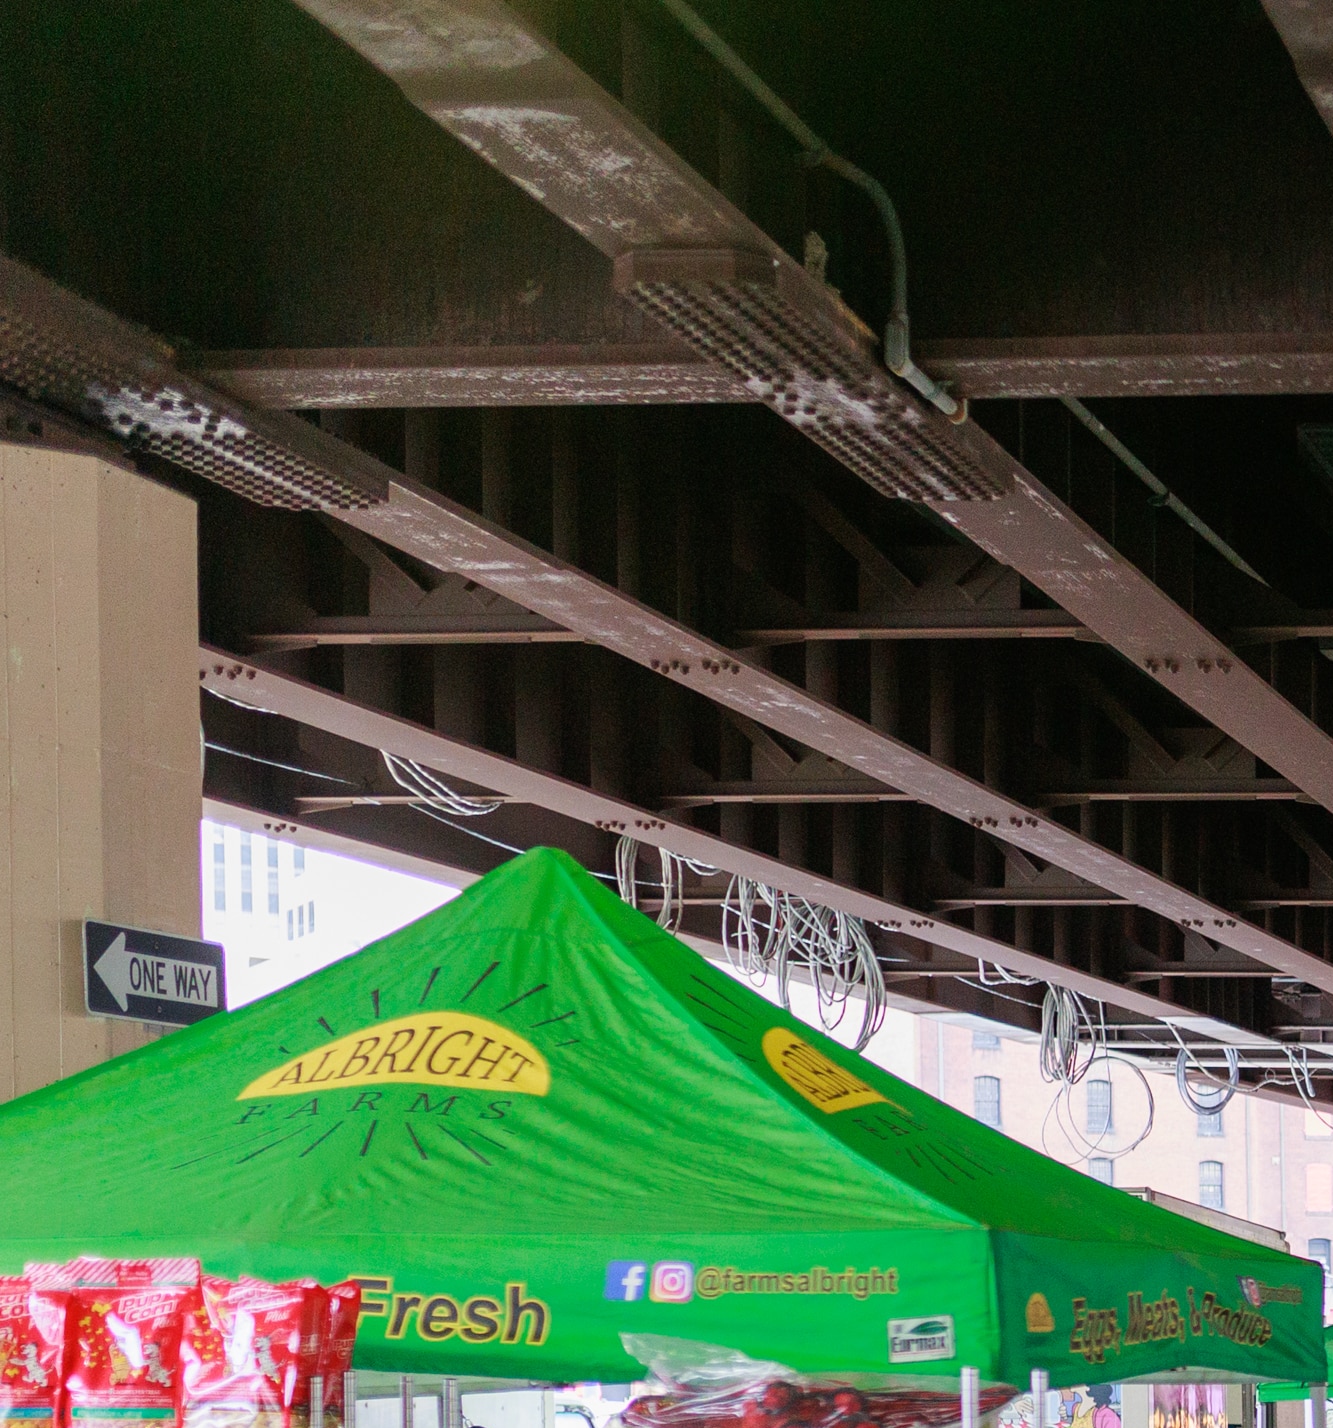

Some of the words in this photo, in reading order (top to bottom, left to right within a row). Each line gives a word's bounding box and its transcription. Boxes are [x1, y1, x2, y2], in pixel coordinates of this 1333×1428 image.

[129, 957, 167, 995] ONE
[173, 964, 211, 1002] WAY
[268, 1025, 535, 1089] ALBRIGHT
[235, 1091, 512, 1124] FARMS
[696, 1265, 899, 1301] @farmsalbright
[348, 1275, 549, 1346] Fresh
[1069, 1297, 1122, 1364] Eggs,
[1124, 1288, 1186, 1345] Meats,
[1202, 1291, 1272, 1348] Produce
